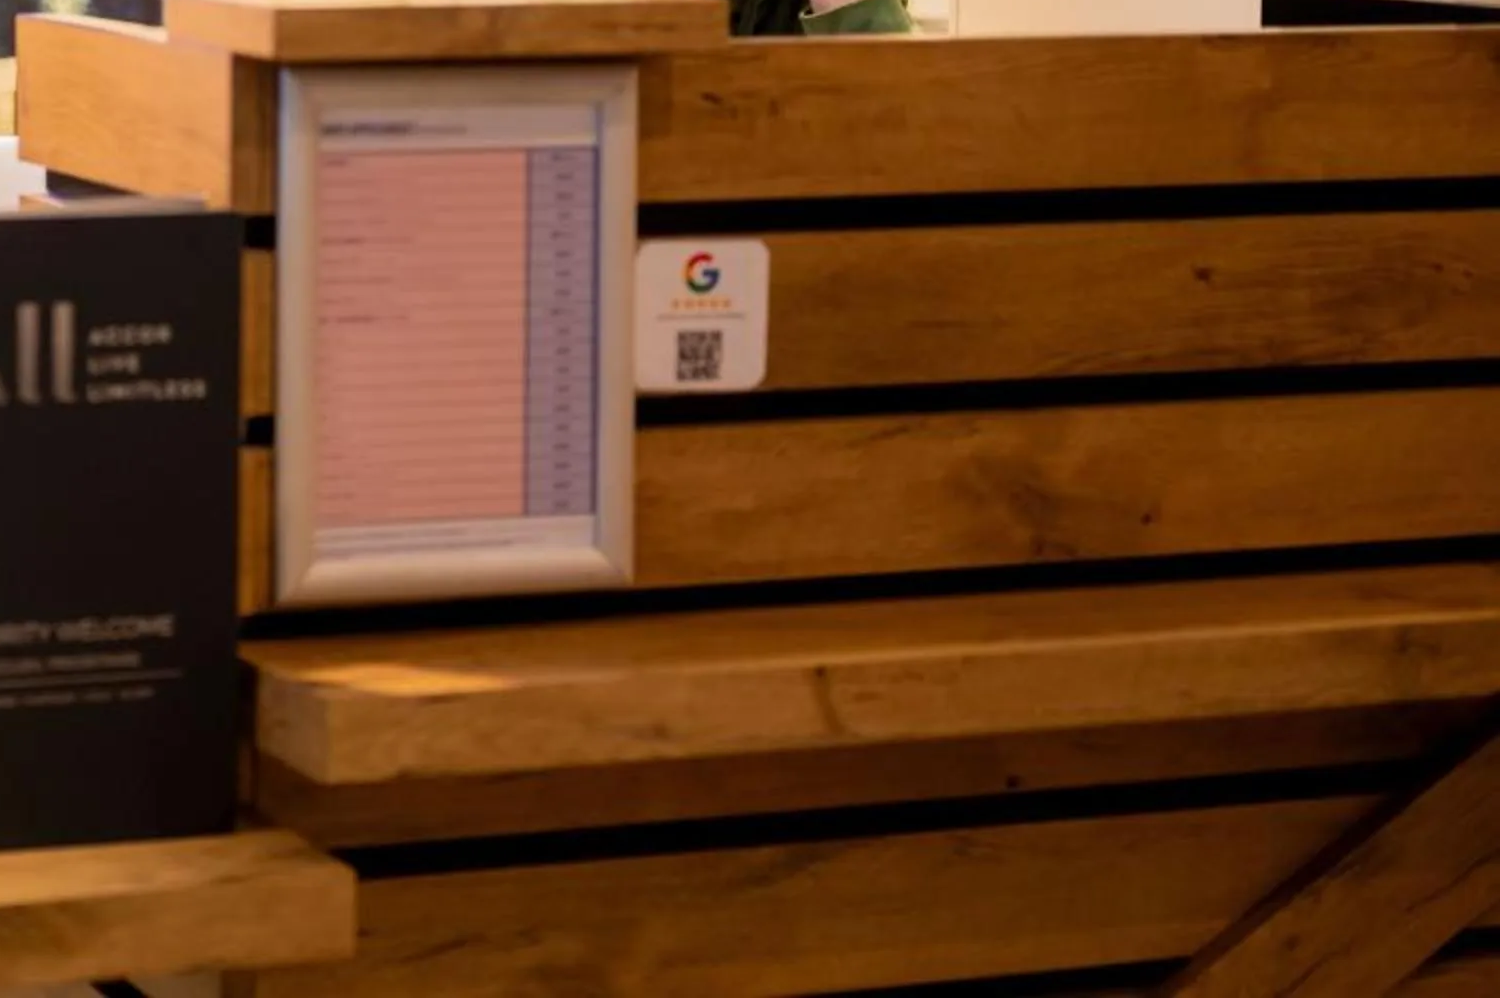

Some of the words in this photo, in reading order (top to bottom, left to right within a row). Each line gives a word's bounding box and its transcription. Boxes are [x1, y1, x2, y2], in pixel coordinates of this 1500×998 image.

[88, 323, 173, 347] ACCOR
[87, 353, 140, 376] LIVE
[86, 377, 207, 403] LIMITLESS
